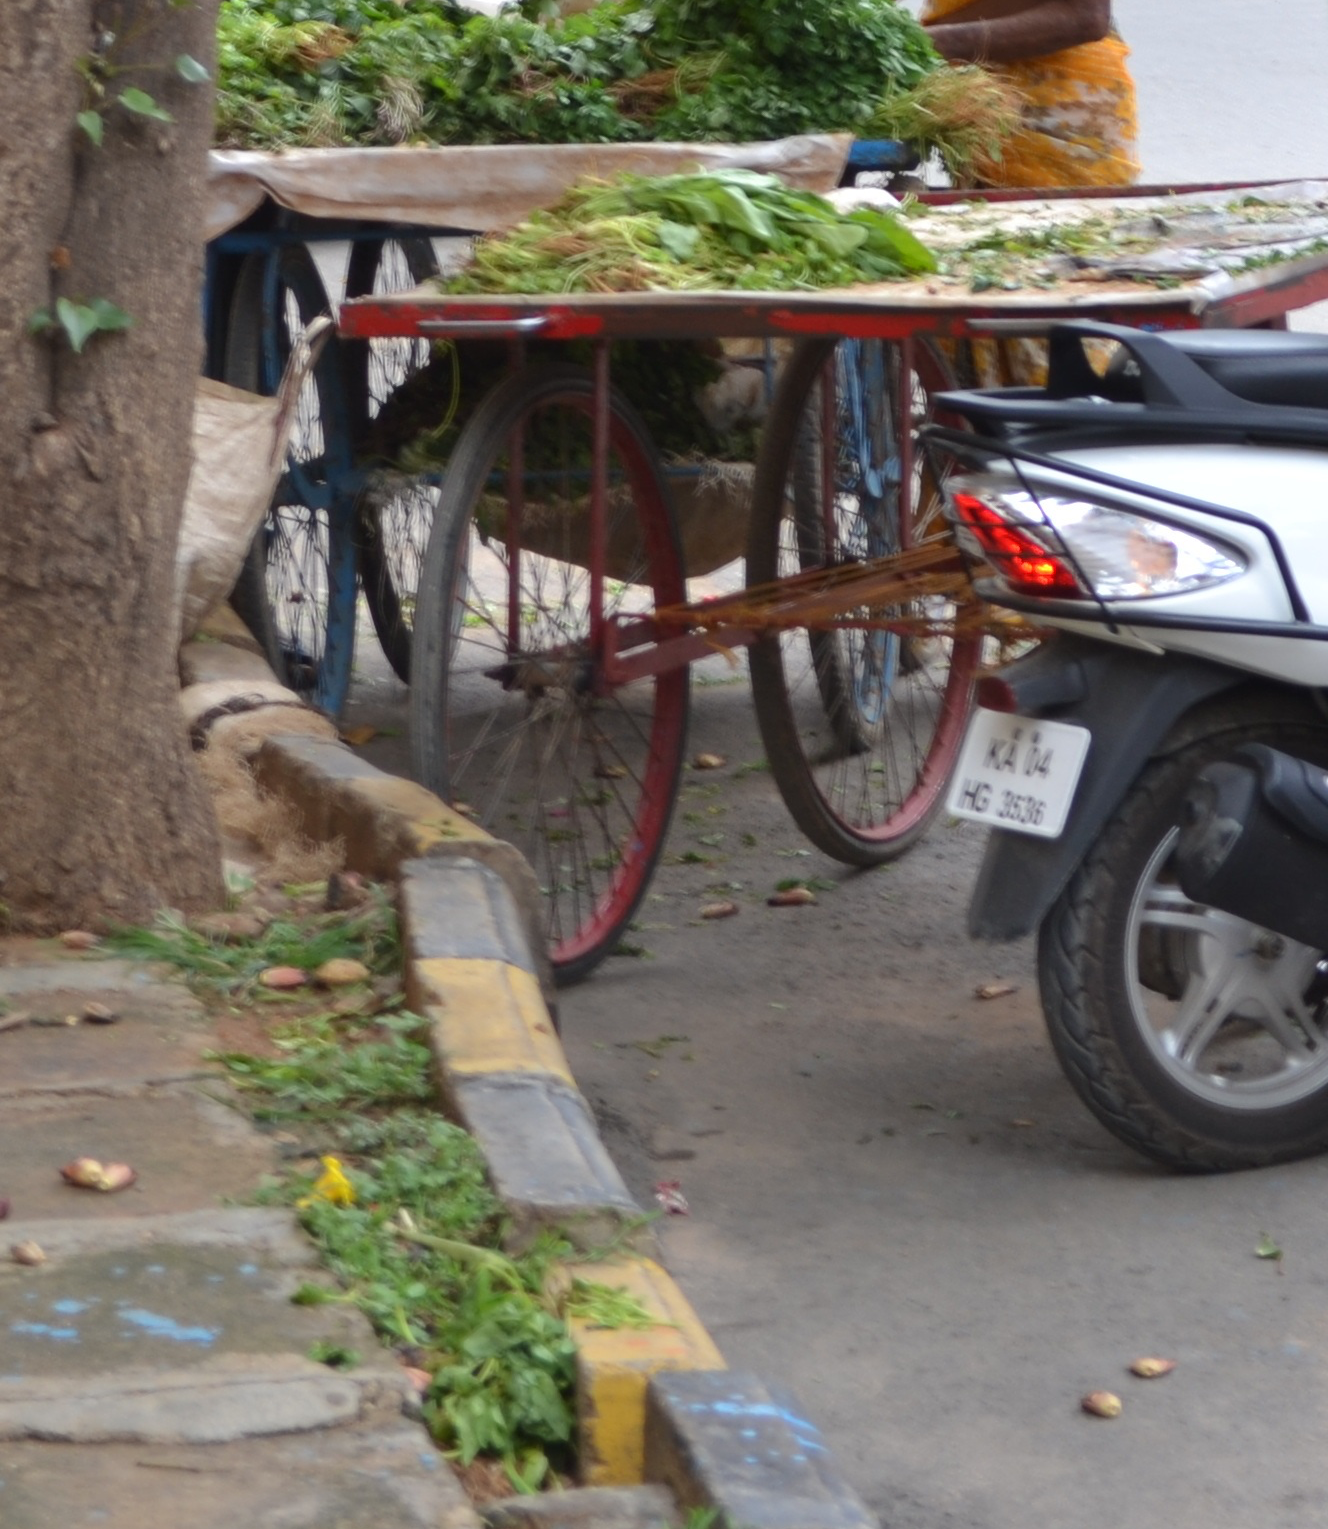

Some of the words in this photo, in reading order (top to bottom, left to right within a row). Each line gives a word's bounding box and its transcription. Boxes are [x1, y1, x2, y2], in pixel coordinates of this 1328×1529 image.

[984, 737, 1018, 774] KA
[1023, 745, 1055, 779] 04
[958, 777, 993, 814] HG
